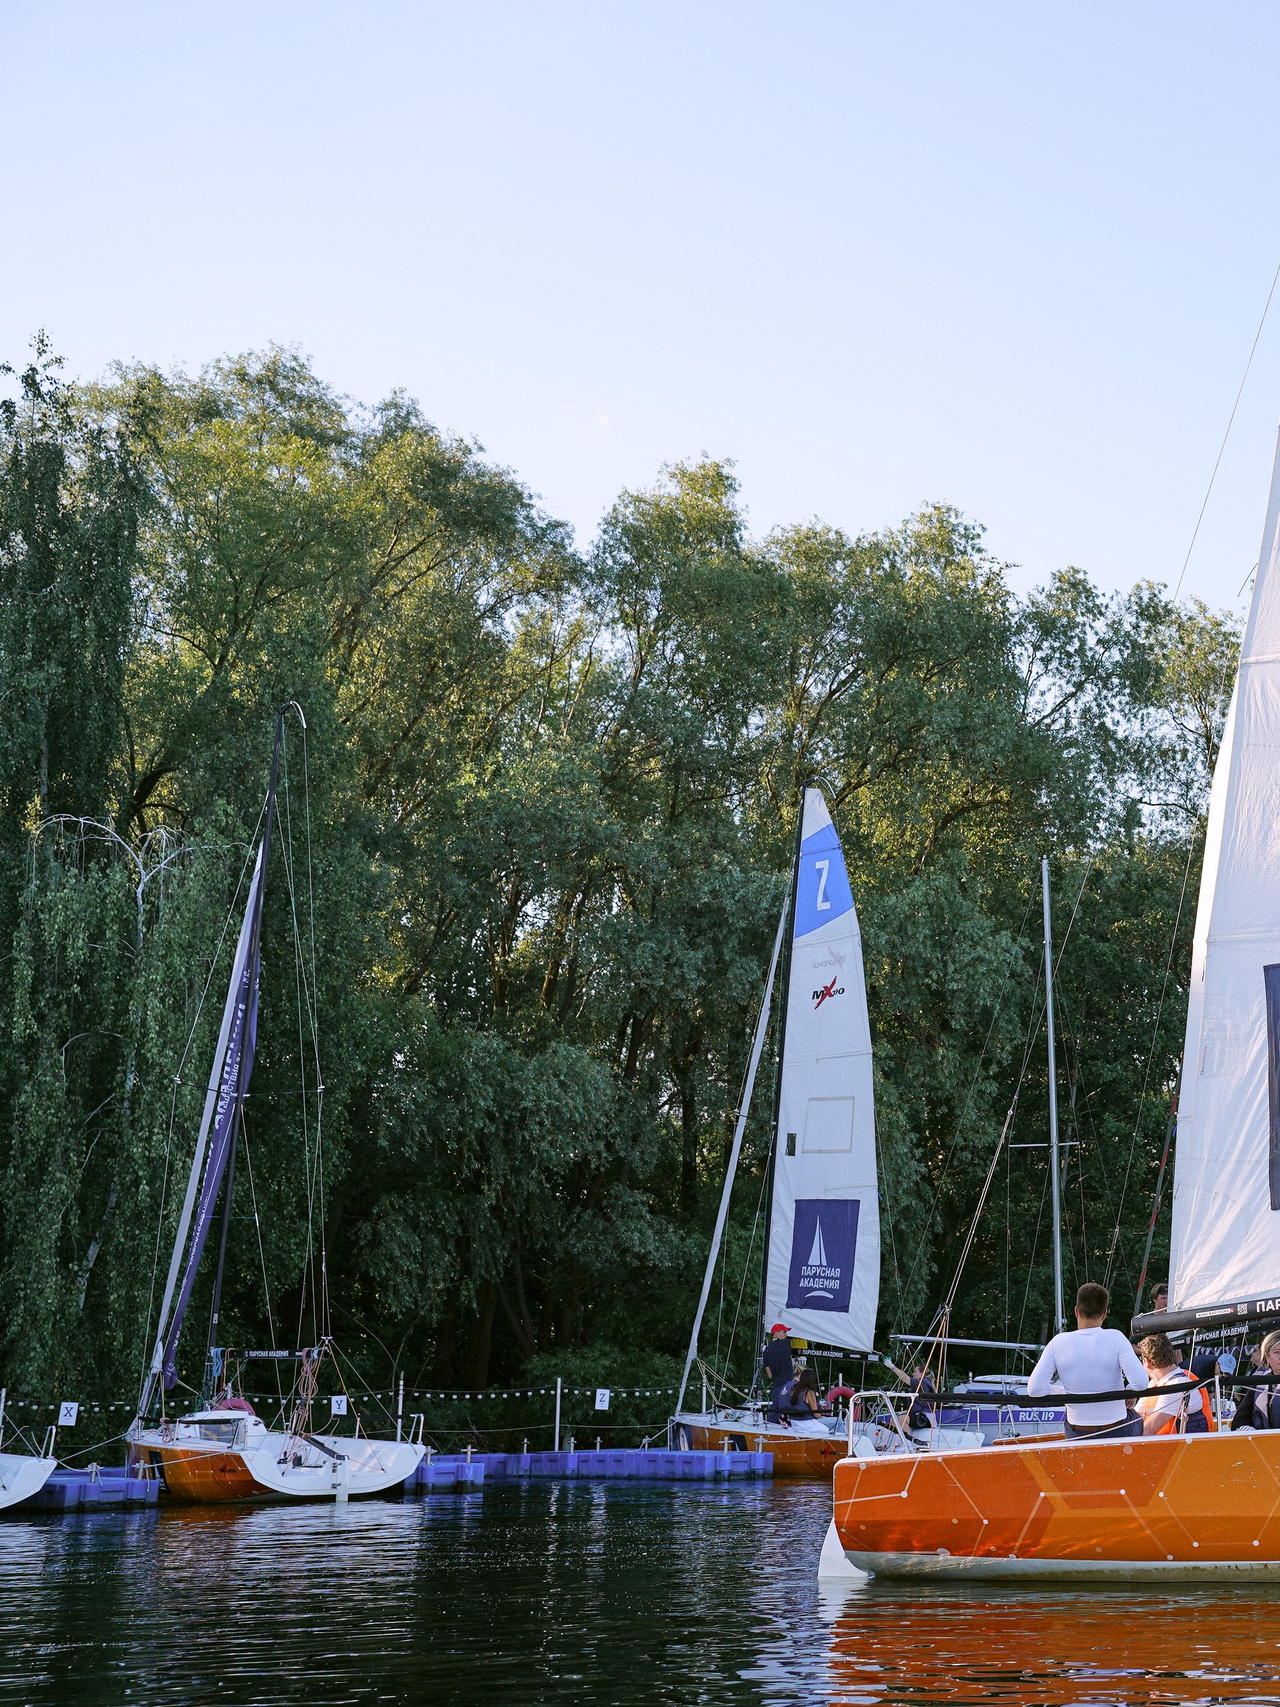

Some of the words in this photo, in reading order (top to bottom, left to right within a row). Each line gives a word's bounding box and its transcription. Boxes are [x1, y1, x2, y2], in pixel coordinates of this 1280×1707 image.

[815, 860, 831, 911] Z
[801, 1266, 841, 1278] ПАРУСНАЯ
[799, 1278, 840, 1290] АКАДЕМИЯ
[599, 1392, 606, 1403] Z
[335, 1399, 343, 1410] Y
[63, 1406, 74, 1417] X
[1019, 1411, 1040, 1421] RUS
[1041, 1411, 1055, 1421] 119
